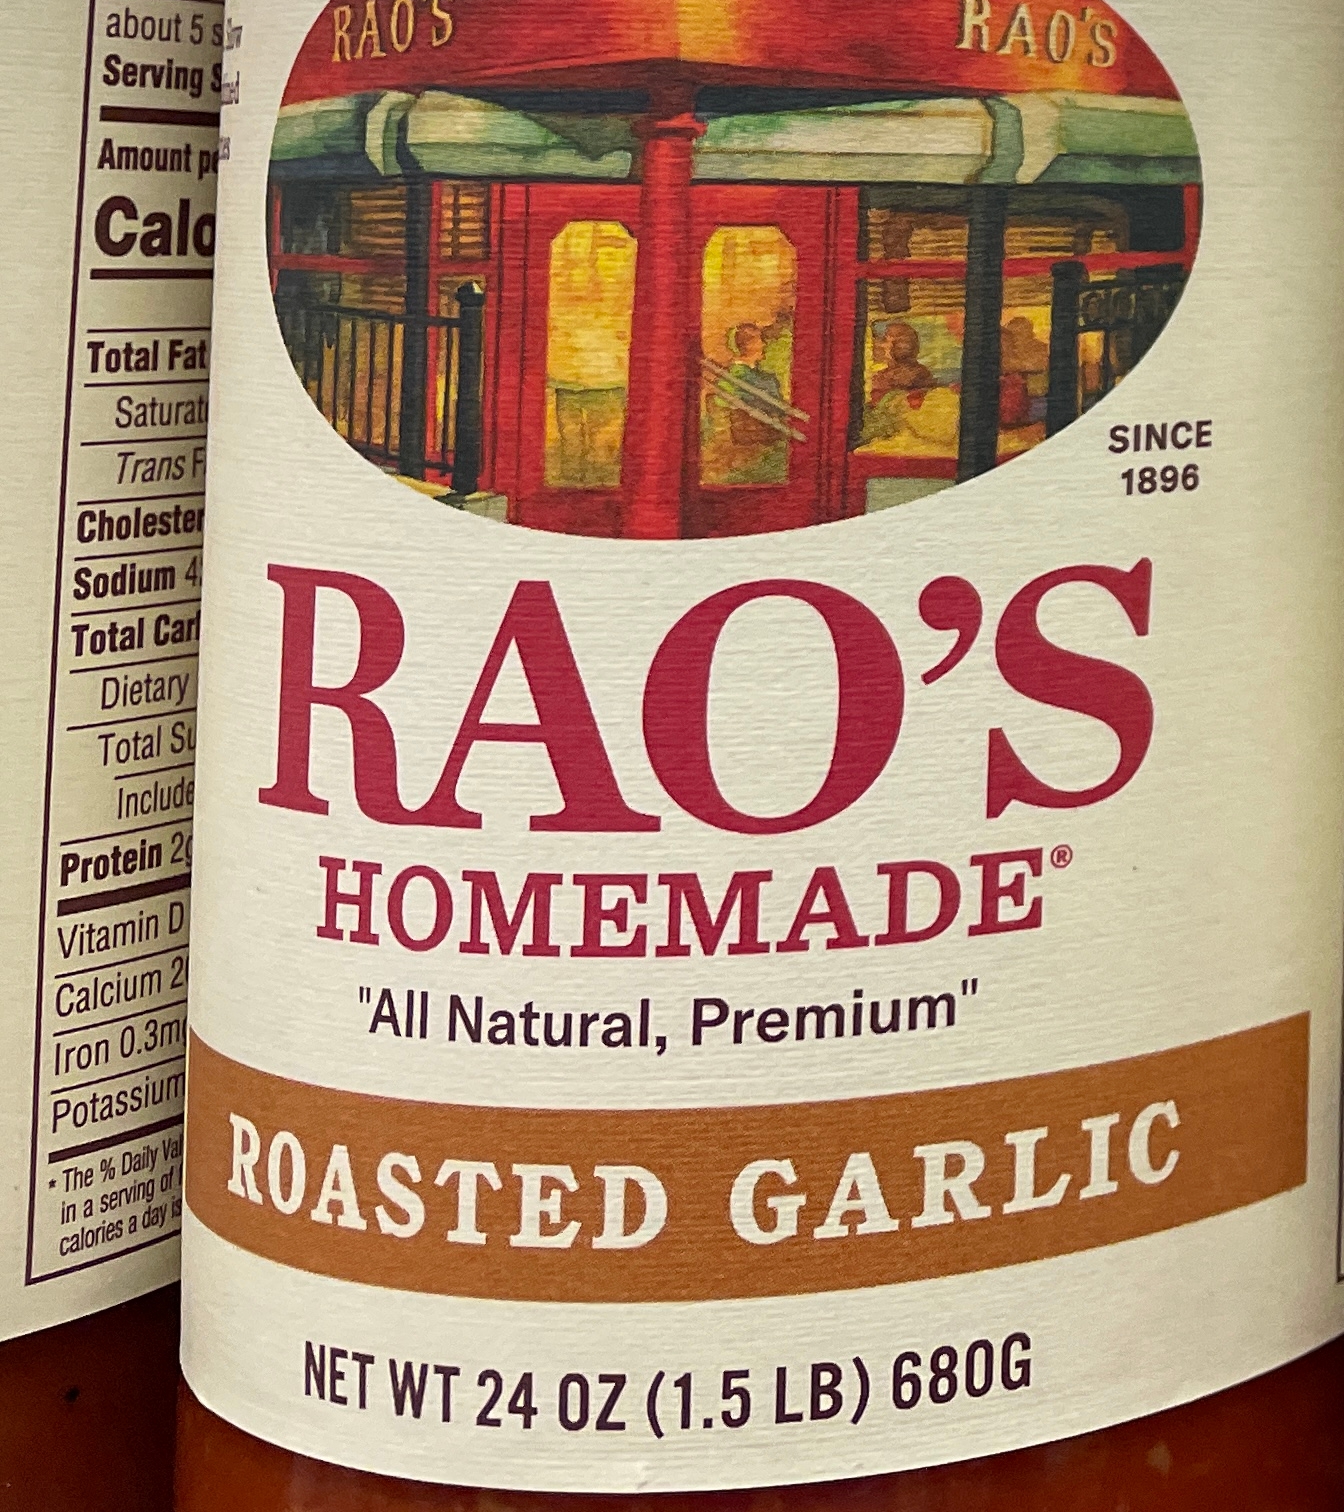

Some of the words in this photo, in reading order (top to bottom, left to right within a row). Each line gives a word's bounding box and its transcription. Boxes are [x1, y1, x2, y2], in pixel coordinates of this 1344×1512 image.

[106, 7, 182, 43] about
[189, 14, 204, 45] 5
[103, 54, 204, 99] Serving
[97, 138, 191, 172] Amount
[87, 340, 159, 373] Total
[1108, 419, 1213, 456] SINCE
[117, 451, 186, 485] Trans
[1120, 463, 1200, 497] 1896
[73, 563, 175, 600] Sodium
[71, 617, 144, 657] Total
[101, 672, 190, 710] Dietary
[258, 558, 1154, 836] RAO'S
[98, 725, 162, 767] Total
[60, 839, 162, 887] Protein
[57, 911, 158, 959] Vitamin
[169, 901, 184, 935] D
[55, 969, 162, 1017] Calcium
[358, 984, 428, 1040] "All
[447, 993, 669, 1055] Natural,
[691, 979, 980, 1047] Premium"
[54, 1037, 110, 1076] Iron
[63, 1166, 94, 1193] The
[100, 1157, 116, 1184] %
[121, 1144, 158, 1176] Daily
[226, 1112, 669, 1252] ROASTED
[729, 1098, 1183, 1248] GARLIC
[61, 1200, 76, 1225] in
[83, 1198, 94, 1218] a
[100, 1178, 155, 1214] serving
[160, 1168, 174, 1192] of
[59, 1219, 124, 1257] calories
[127, 1214, 138, 1235] a
[142, 1203, 167, 1229] day
[304, 1340, 373, 1411] NET
[390, 1358, 461, 1425] WT
[476, 1367, 538, 1431] 24
[558, 1370, 627, 1433] OZ
[646, 1364, 752, 1439] (1.5
[774, 1354, 872, 1427] LB)
[891, 1331, 1034, 1411] 680G
